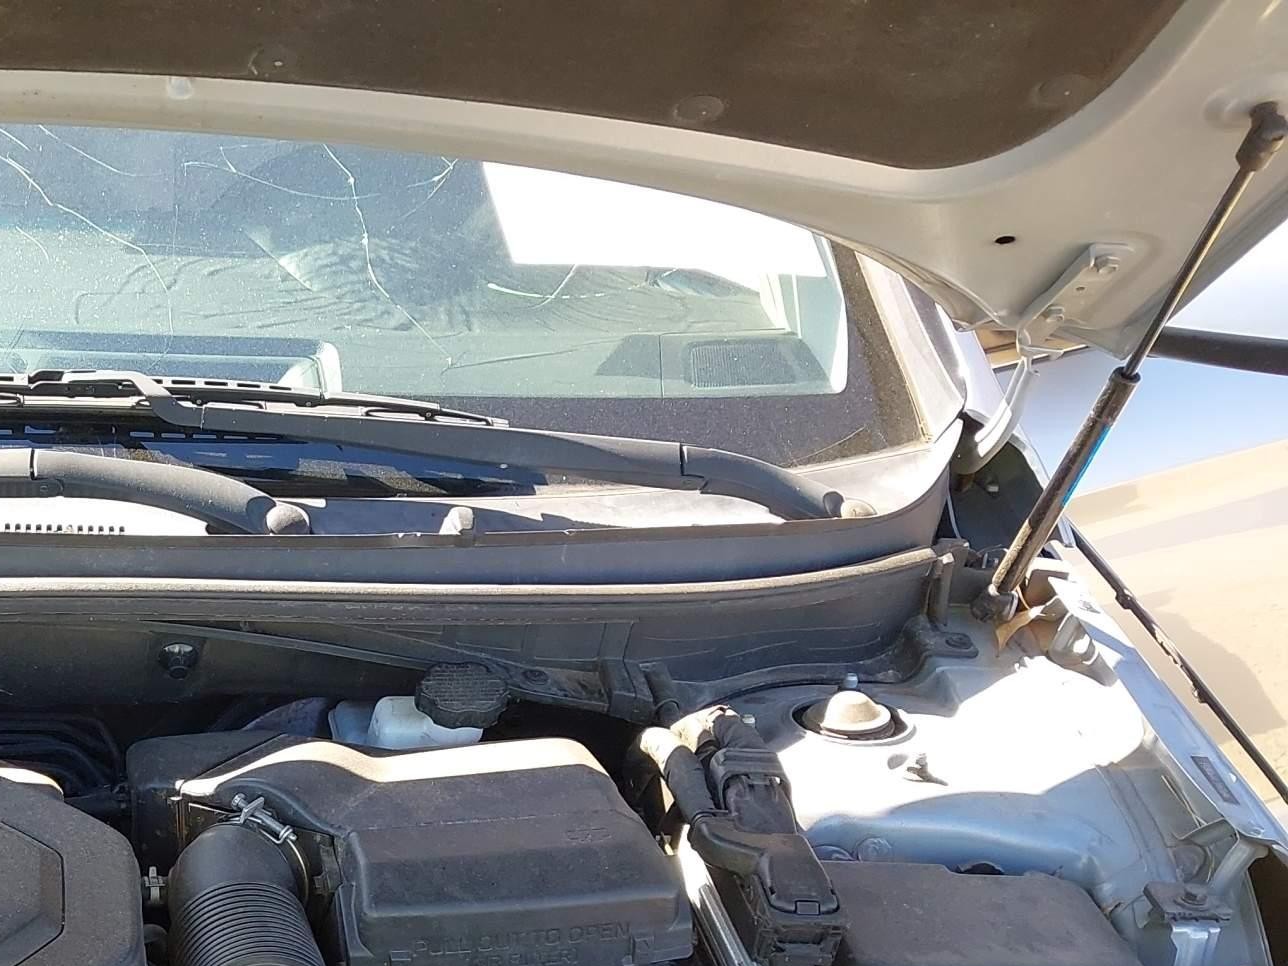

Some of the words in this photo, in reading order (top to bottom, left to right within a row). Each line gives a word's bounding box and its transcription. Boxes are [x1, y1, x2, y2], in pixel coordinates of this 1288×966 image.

[414, 936, 472, 957] PULL
[477, 931, 526, 952] OUT
[530, 927, 562, 947] TO
[569, 921, 631, 945] OPEN
